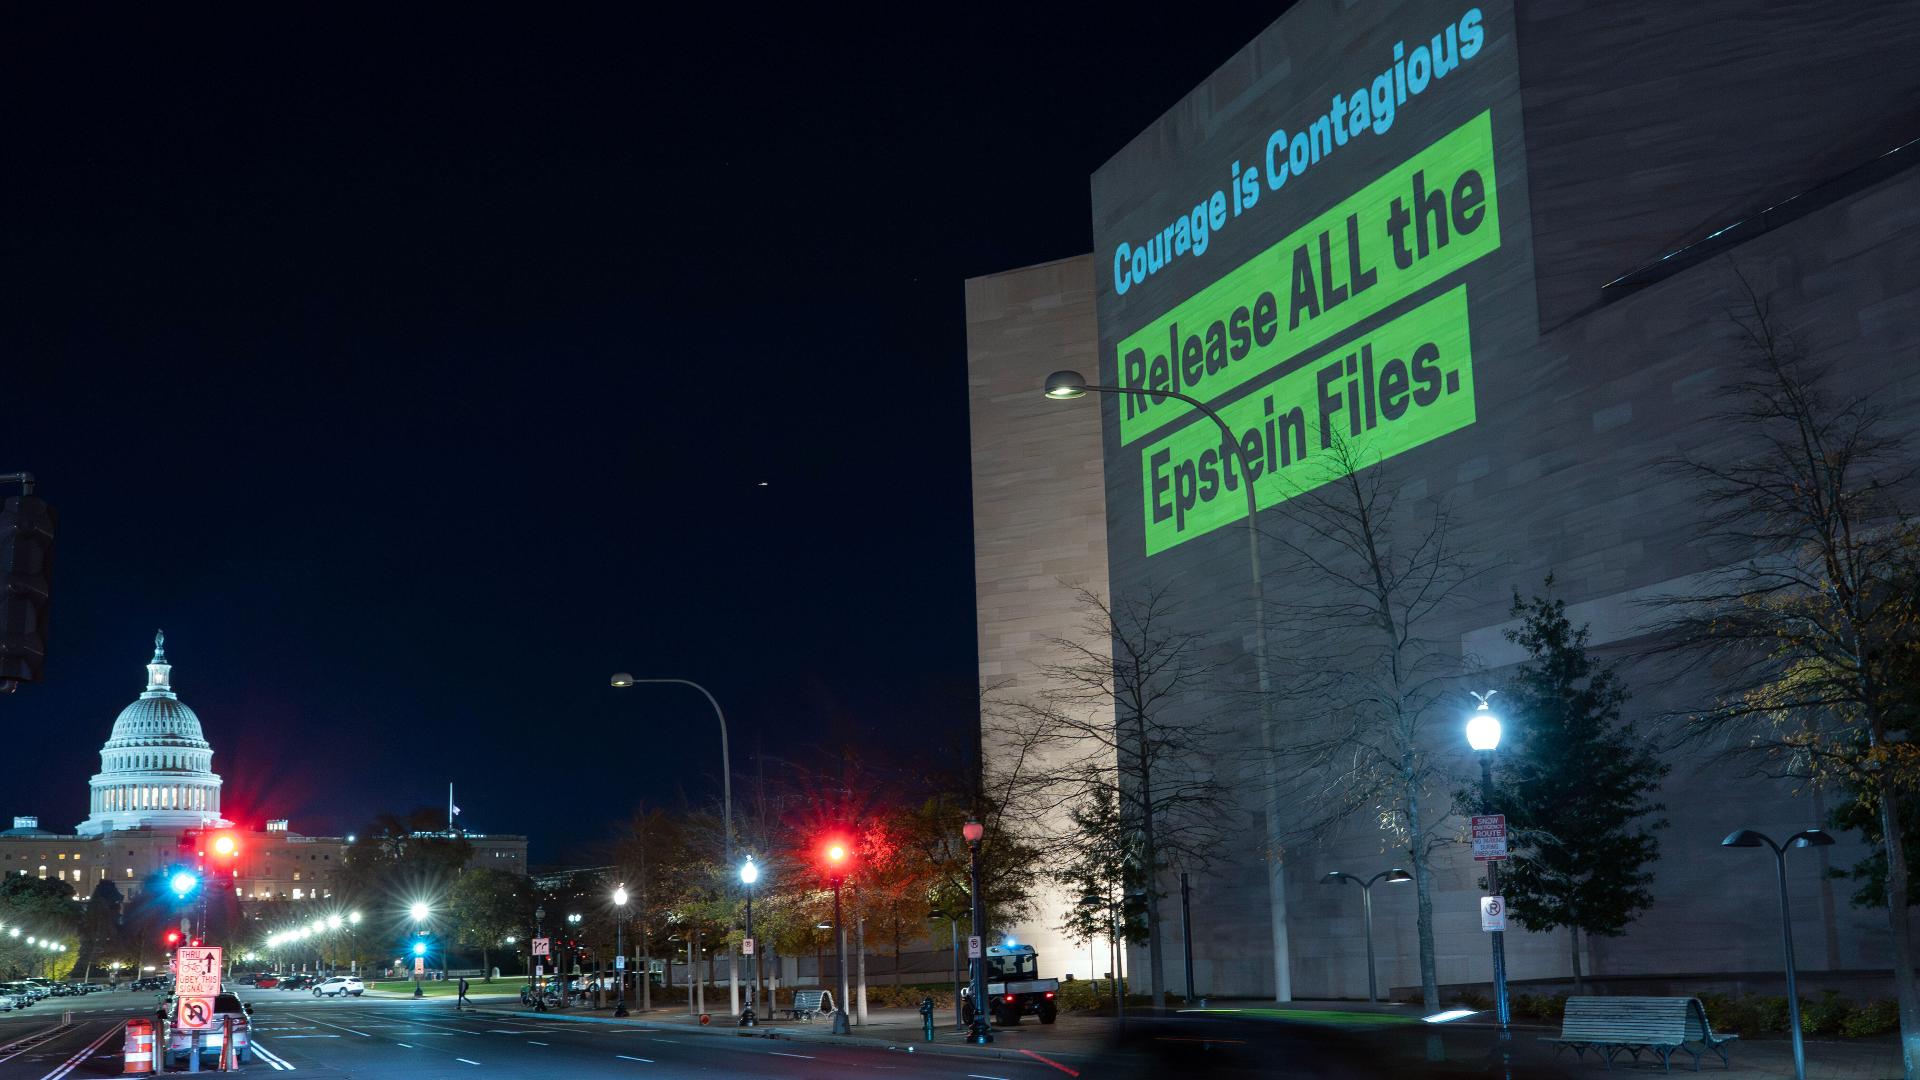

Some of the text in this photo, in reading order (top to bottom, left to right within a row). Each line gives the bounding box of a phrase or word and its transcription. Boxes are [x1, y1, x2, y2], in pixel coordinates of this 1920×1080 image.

[1114, 7, 1484, 296] Courage is Contagious
[1125, 169, 1486, 421] Release ALL the
[1150, 341, 1460, 532] Epstein Files.
[1476, 817, 1499, 825] SNOW
[182, 950, 200, 959] THRU
[180, 975, 217, 983] OBEY THIS
[180, 984, 205, 992] SIGNAL
